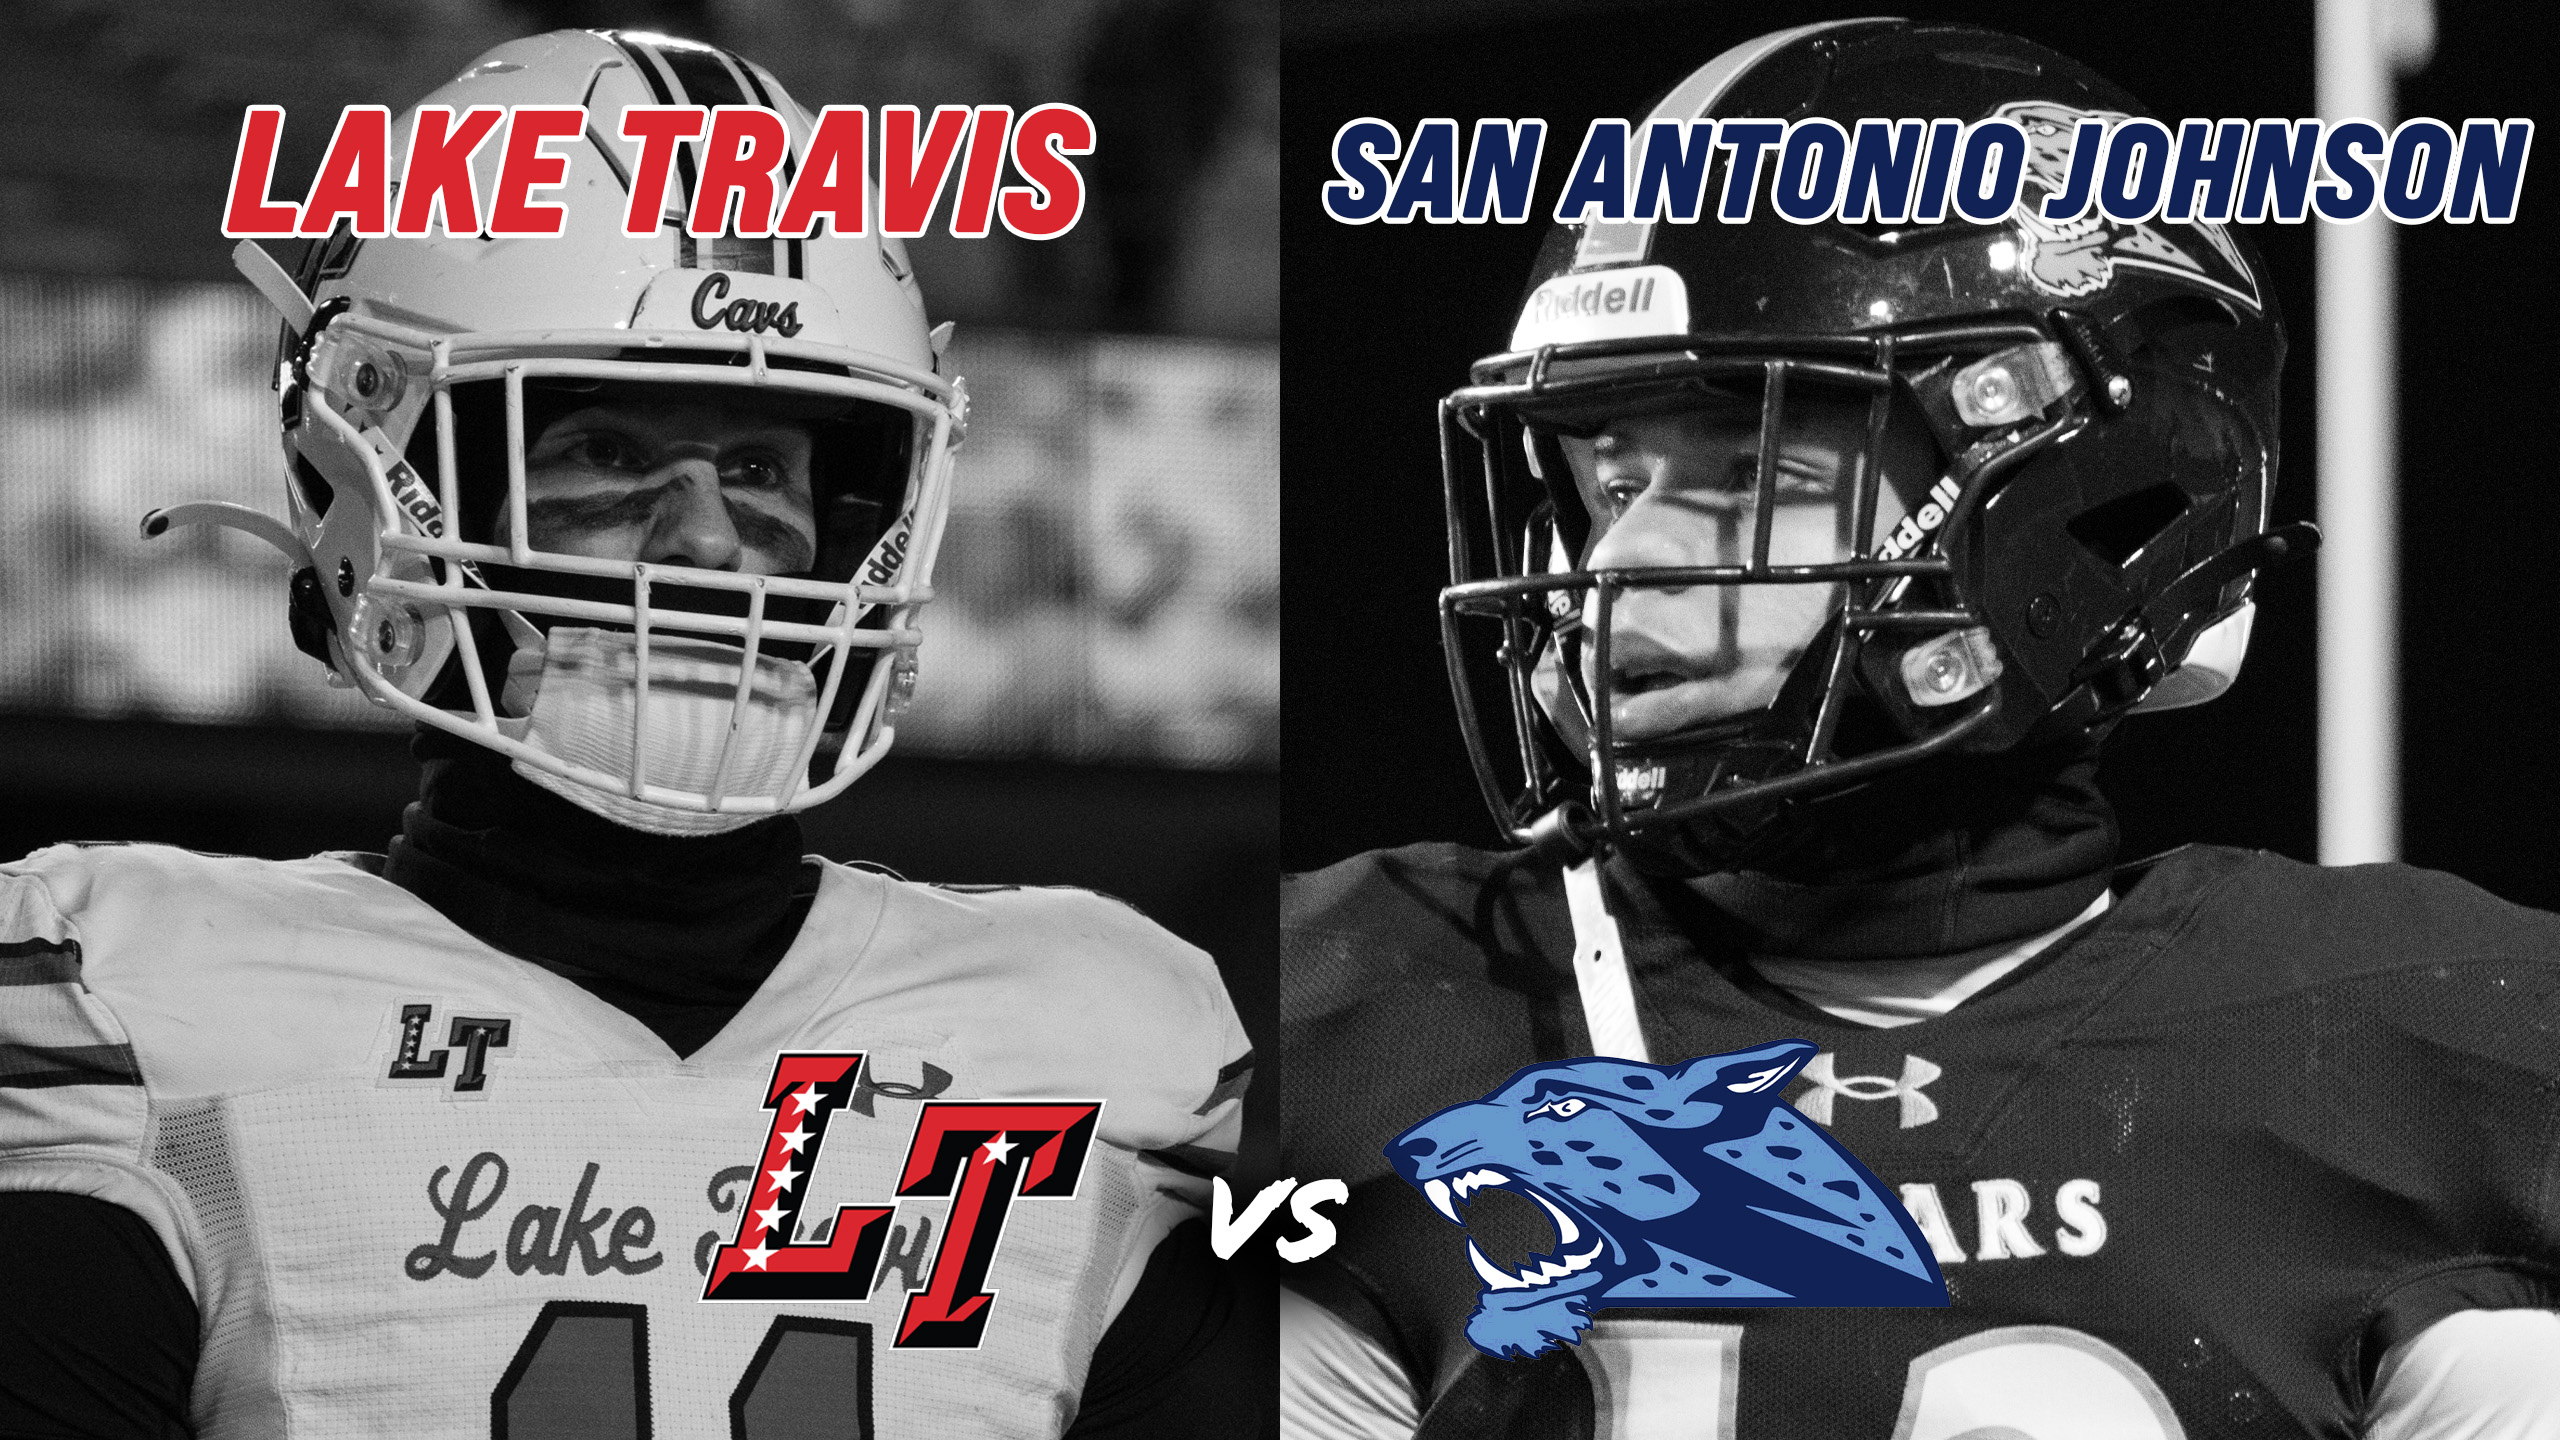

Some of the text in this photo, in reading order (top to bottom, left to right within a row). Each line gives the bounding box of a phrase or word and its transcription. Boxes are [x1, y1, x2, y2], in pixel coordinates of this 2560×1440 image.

[691, 272, 803, 338] Cavs
[1878, 475, 1961, 561] ddell
[388, 1004, 511, 1092] LT
[405, 1152, 662, 1281] Lake
